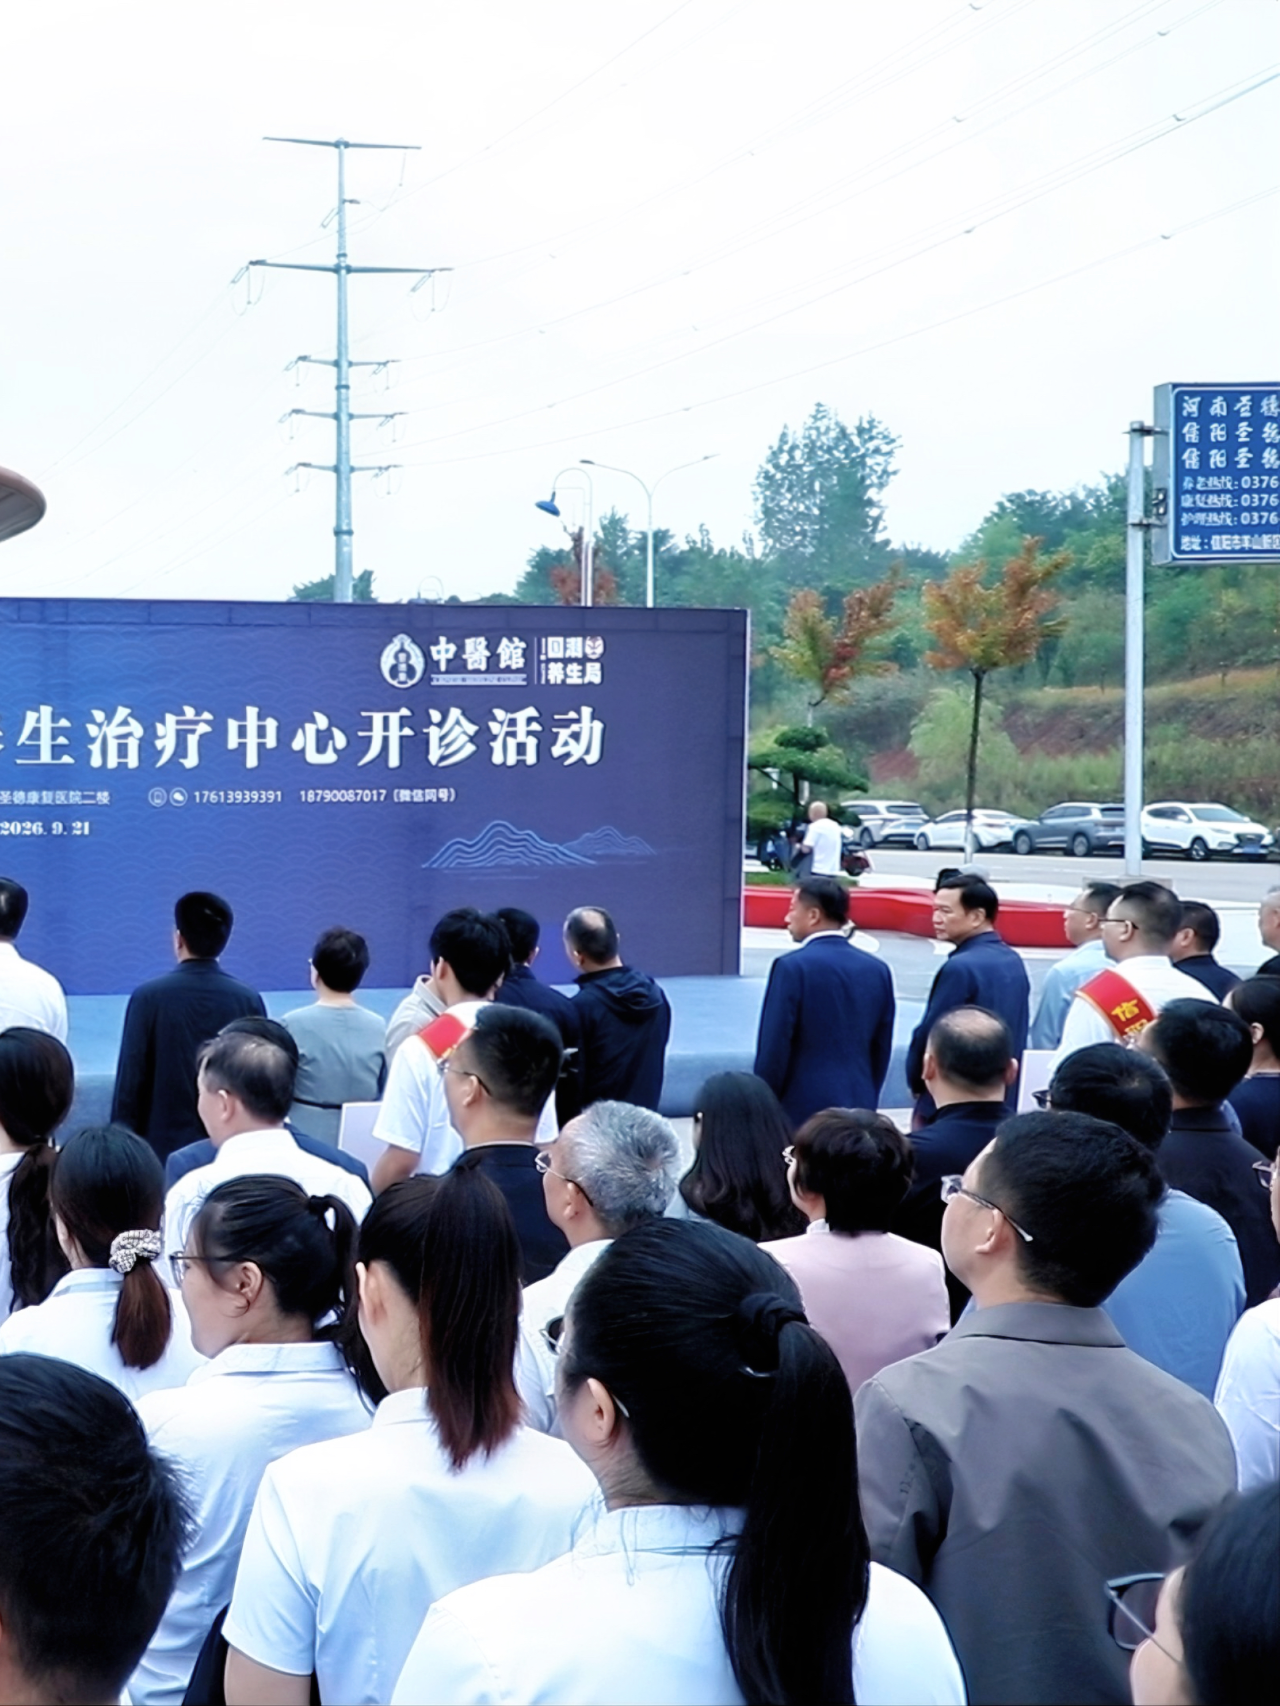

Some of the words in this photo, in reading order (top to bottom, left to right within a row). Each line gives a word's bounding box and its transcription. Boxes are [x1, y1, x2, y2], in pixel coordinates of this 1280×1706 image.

[429, 636, 527, 672] 中醫館
[547, 662, 602, 685] 养生局
[193, 790, 283, 804] 17613939391
[300, 789, 387, 803] 18790087017
